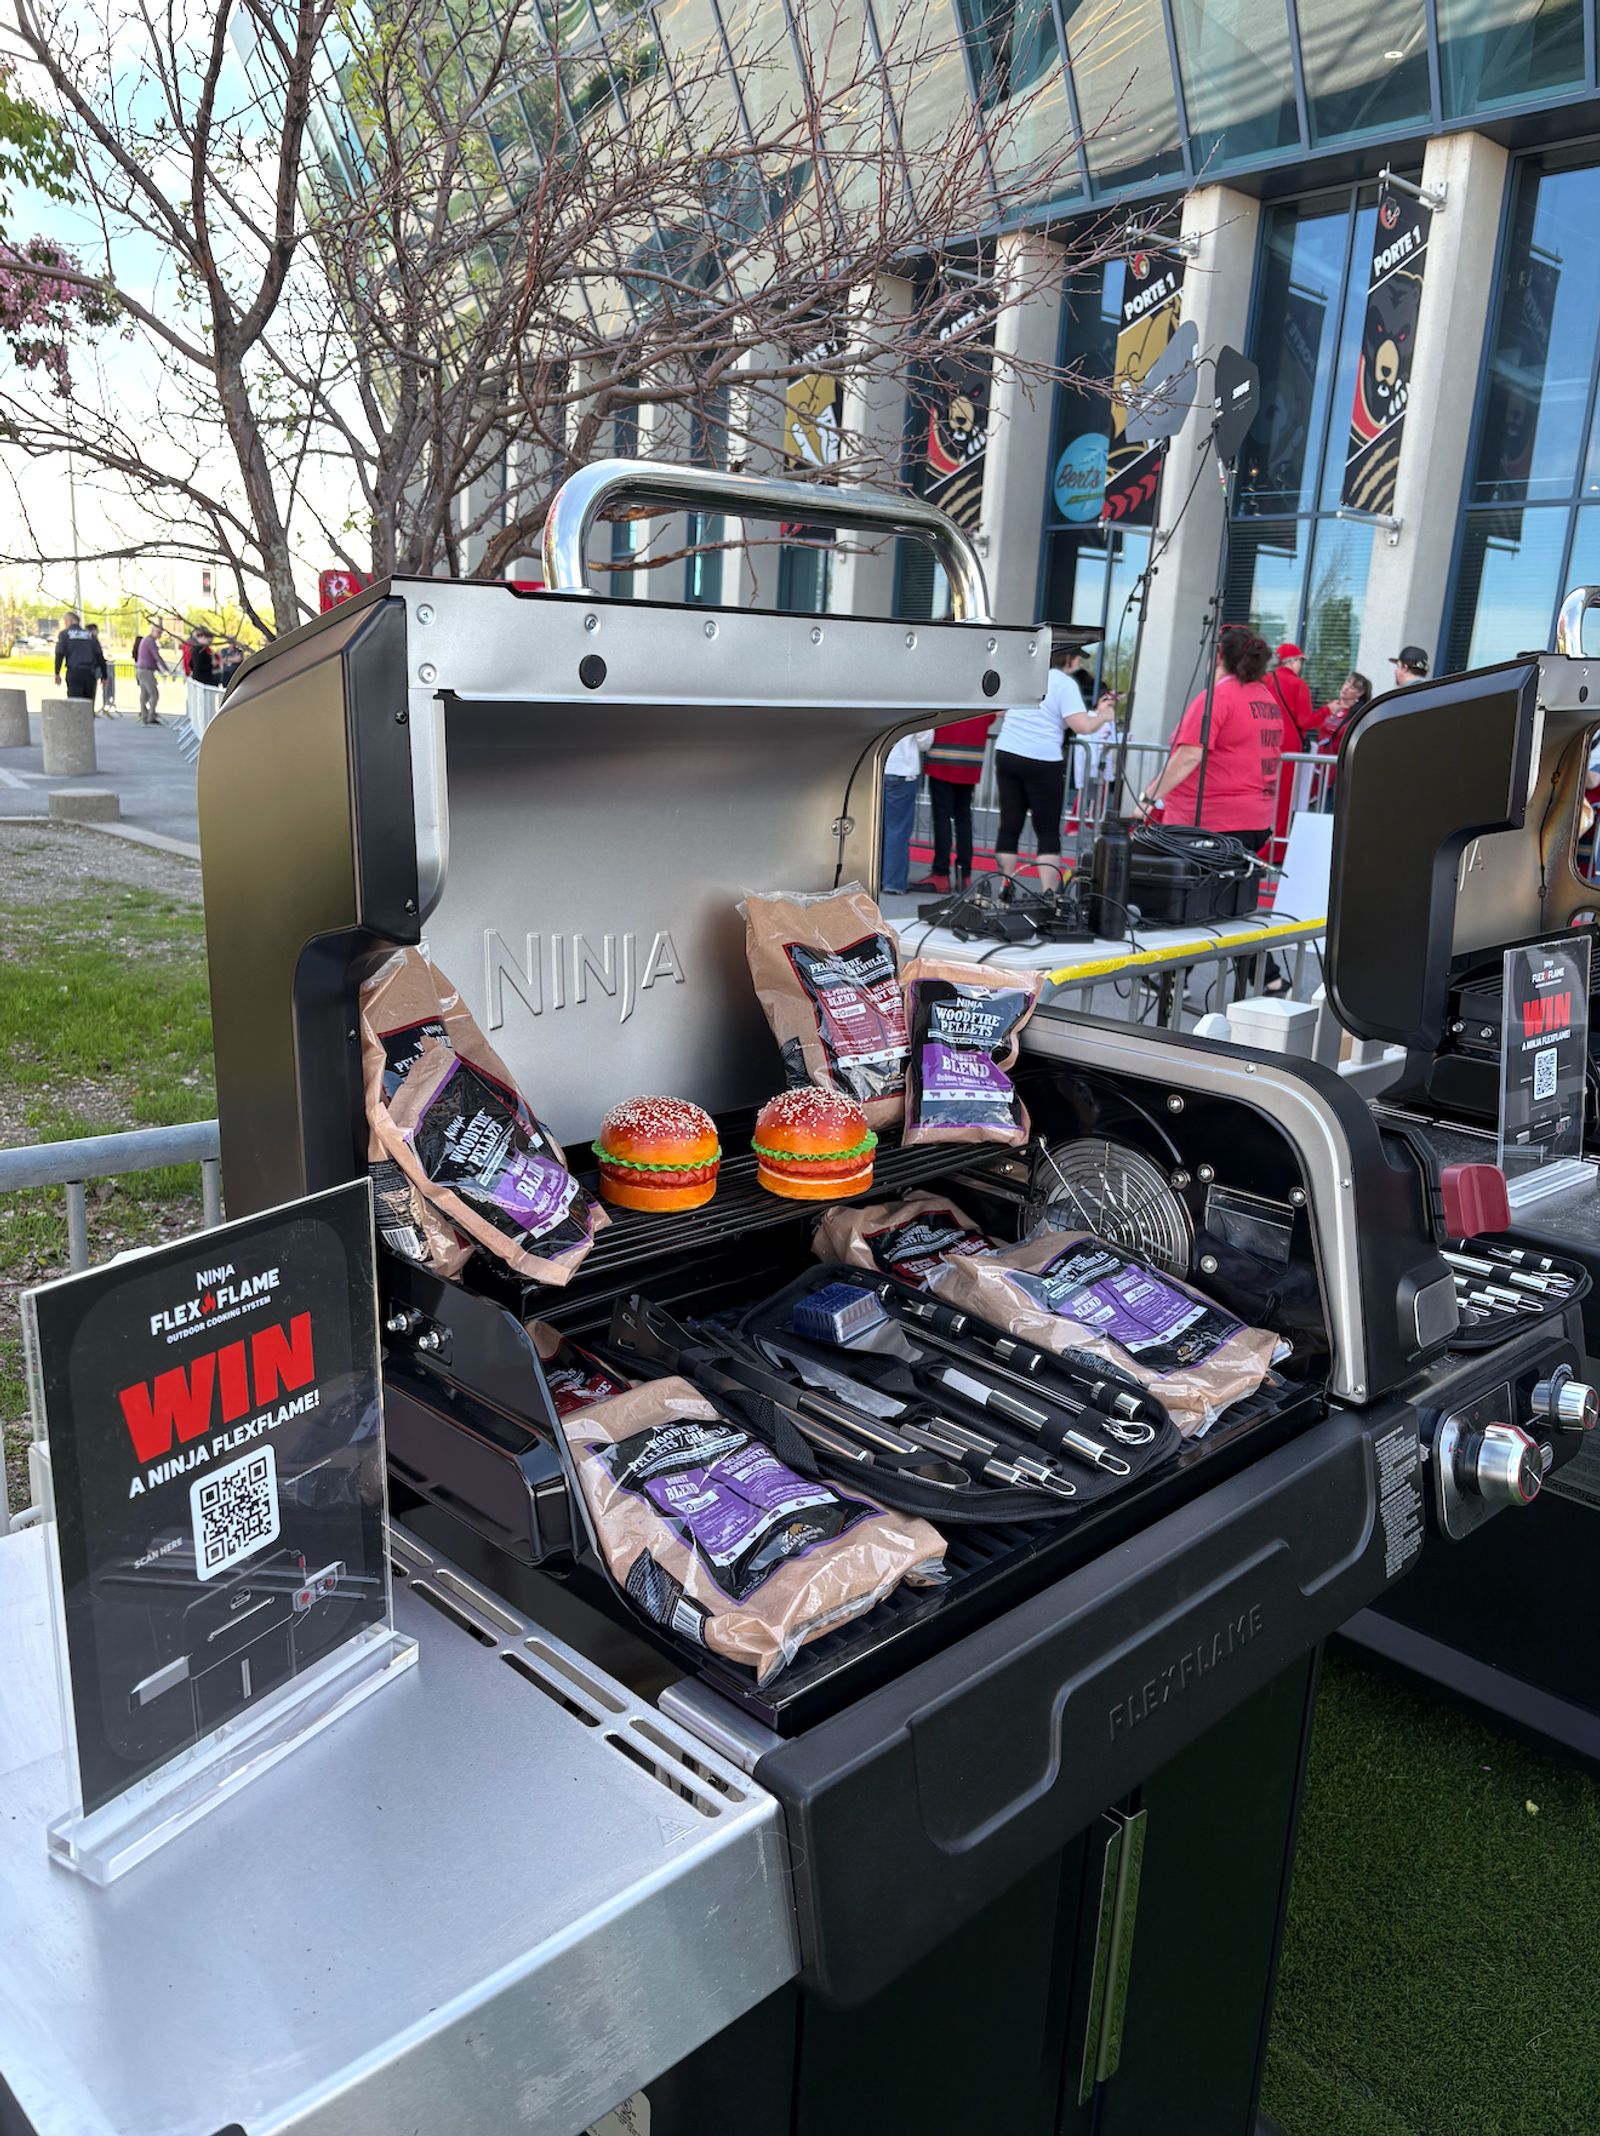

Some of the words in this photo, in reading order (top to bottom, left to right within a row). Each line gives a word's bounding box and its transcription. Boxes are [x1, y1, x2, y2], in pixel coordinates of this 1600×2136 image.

[1373, 231, 1413, 277] PORTE
[1412, 225, 1421, 245] 1
[1124, 279, 1167, 321] PORTE
[1165, 271, 1176, 290] 1
[484, 928, 685, 1031] NINJA
[936, 1006, 1001, 1027] WOODFIRE
[957, 998, 984, 1011] NINJA
[1523, 991, 1571, 1038] WIN
[940, 1020, 994, 1037] PELLETS
[1521, 1042, 1527, 1052] A
[941, 1055, 990, 1079] BLEND
[443, 1115, 466, 1142] NINJA
[196, 1263, 236, 1292] NINJA
[150, 1299, 202, 1337] FLEX
[216, 1267, 280, 1309] FLAME
[1072, 1295, 1102, 1319] BLEND
[166, 1322, 206, 1344] OUTDOOR
[206, 1307, 241, 1328] COOKING
[241, 1294, 272, 1314] SYSTEM
[119, 1311, 315, 1465] WIN
[129, 1476, 147, 1499] A
[148, 1446, 210, 1490] NINJA
[212, 1389, 320, 1457] FLEXFLAME!
[628, 1440, 680, 1473] PELLETS
[664, 1481, 701, 1502] BLEND
[133, 1550, 161, 1570] SCAN
[159, 1536, 183, 1557] HERE
[1110, 1603, 1263, 1742] FLEXFLAME
